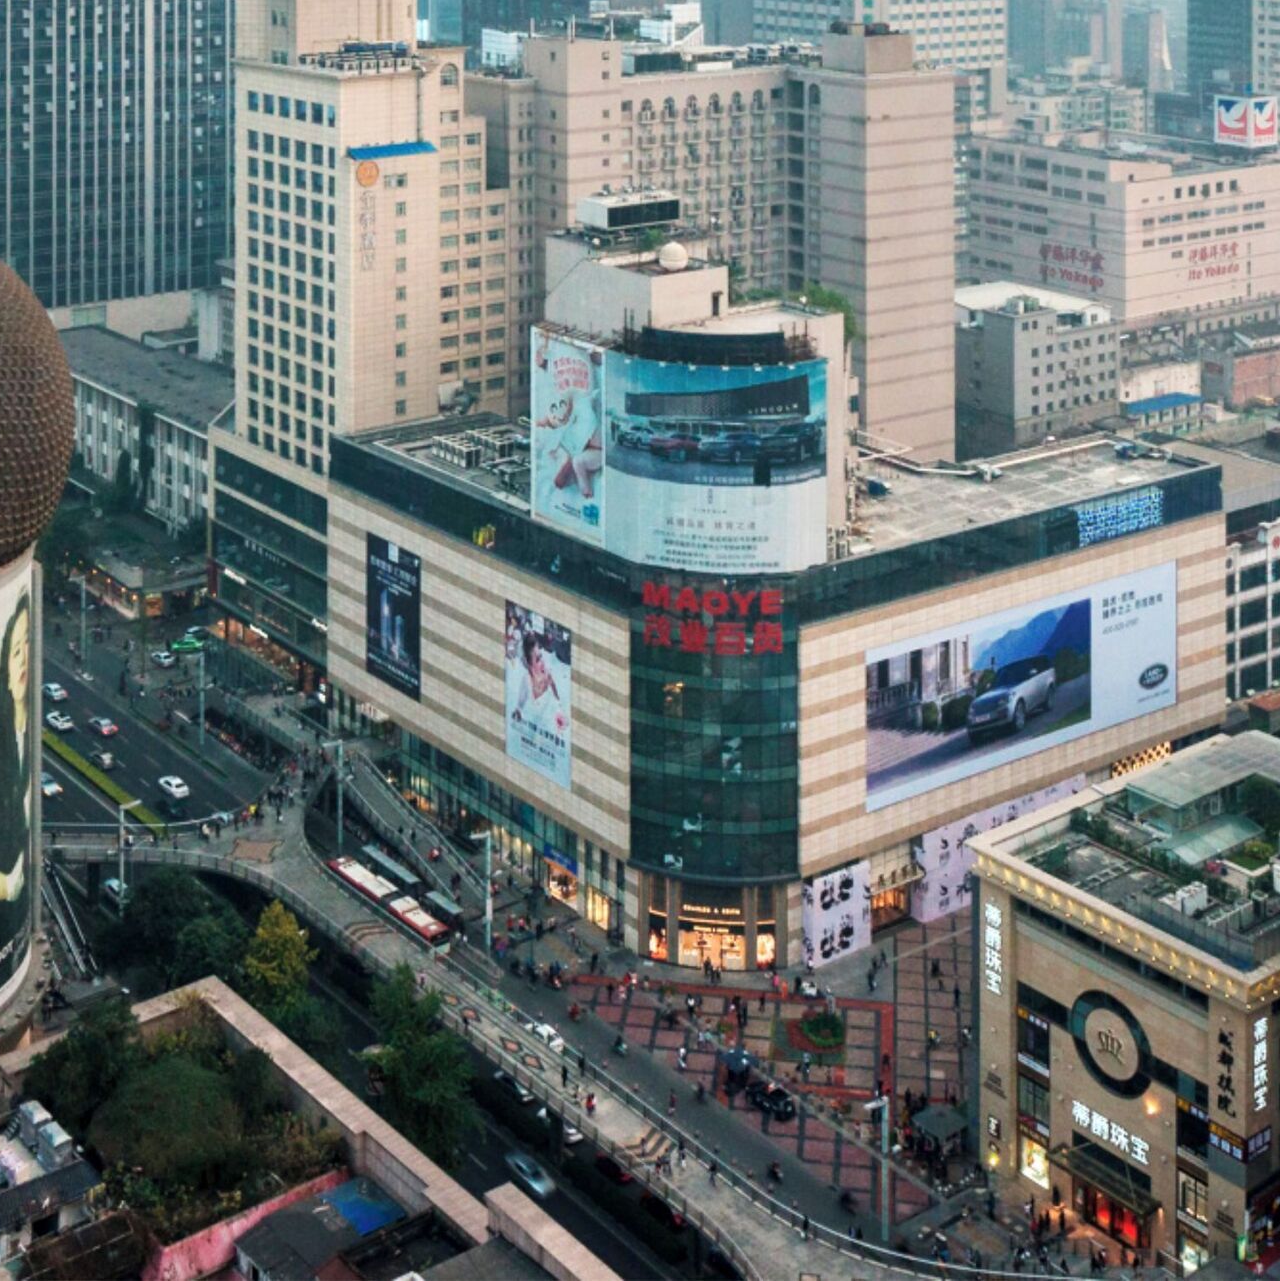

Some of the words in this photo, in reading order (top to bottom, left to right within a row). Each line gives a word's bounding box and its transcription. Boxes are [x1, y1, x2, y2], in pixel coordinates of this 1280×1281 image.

[1188, 241, 1239, 264] 伊藤洋华堂
[1039, 265, 1057, 279] Ito
[1060, 267, 1104, 288] Yokado
[1188, 269, 1201, 281] Ito
[1205, 262, 1240, 277] Yokado
[748, 403, 799, 416] LINCOLN
[641, 581, 783, 616] MAOYE
[643, 614, 783, 655] 茂业百货
